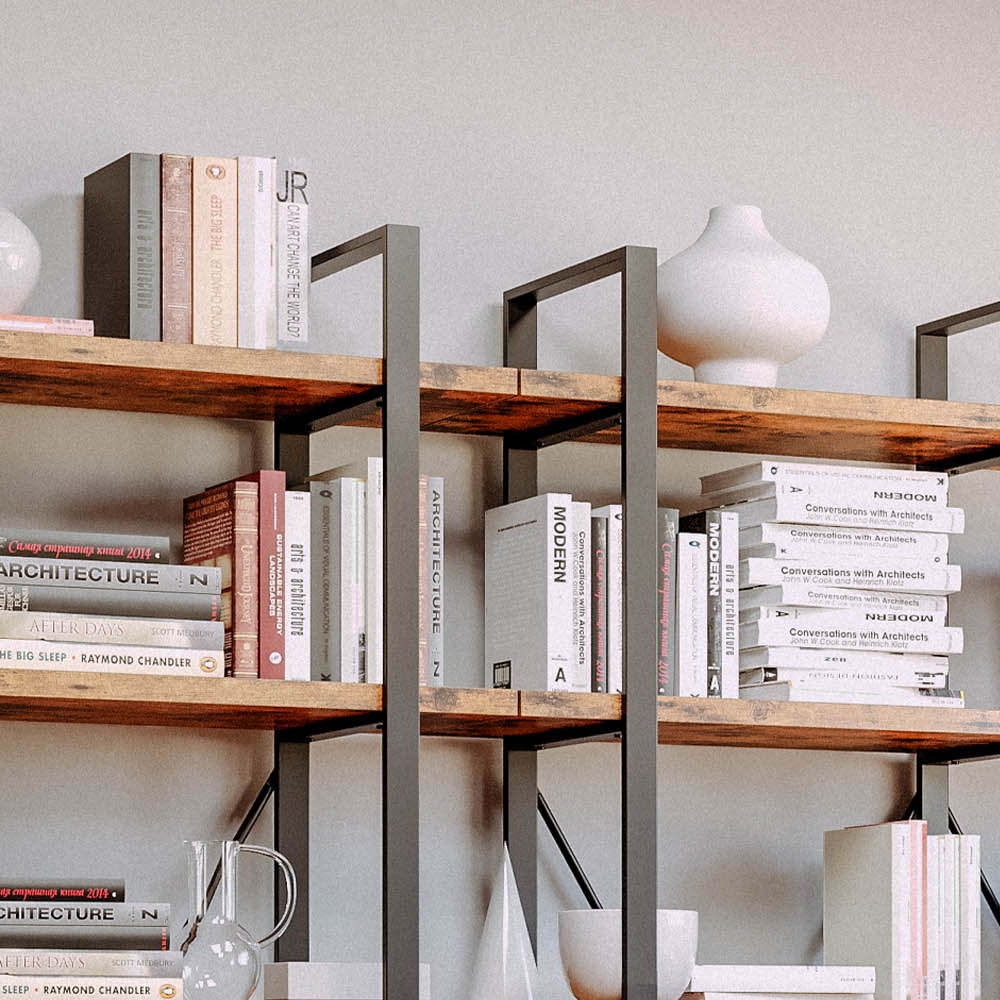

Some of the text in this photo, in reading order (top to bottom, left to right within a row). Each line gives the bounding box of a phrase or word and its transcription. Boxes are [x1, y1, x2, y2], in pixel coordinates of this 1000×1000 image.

[276, 171, 308, 204] JR
[287, 205, 300, 337] CAN ART CHANGE THE WORLD?
[873, 491, 937, 502] MODERN
[805, 504, 933, 522] Conversations with Architects
[554, 506, 566, 583] MODERN
[127, 547, 151, 559] 2014
[709, 523, 720, 596] MODERN
[432, 490, 440, 634] ARCHITECTURE
[781, 567, 925, 579] Conversations with Architects
[30, 619, 79, 634] AFTER
[85, 623, 124, 636] DAYS
[152, 627, 176, 636] SCOTT
[790, 628, 928, 642] Conversations with Architects
[16, 651, 35, 660] BIG
[39, 652, 67, 661] SLEEP
[81, 654, 134, 665] RAYMOND
[138, 656, 191, 667] CHANDLER
[555, 668, 567, 682] A
[710, 675, 720, 691] A
[87, 888, 109, 898] 2014
[47, 957, 85, 969] DAYS
[3, 986, 29, 994] SLEEP
[44, 986, 95, 995] RAYMOND
[99, 986, 150, 995] CHANDLER
